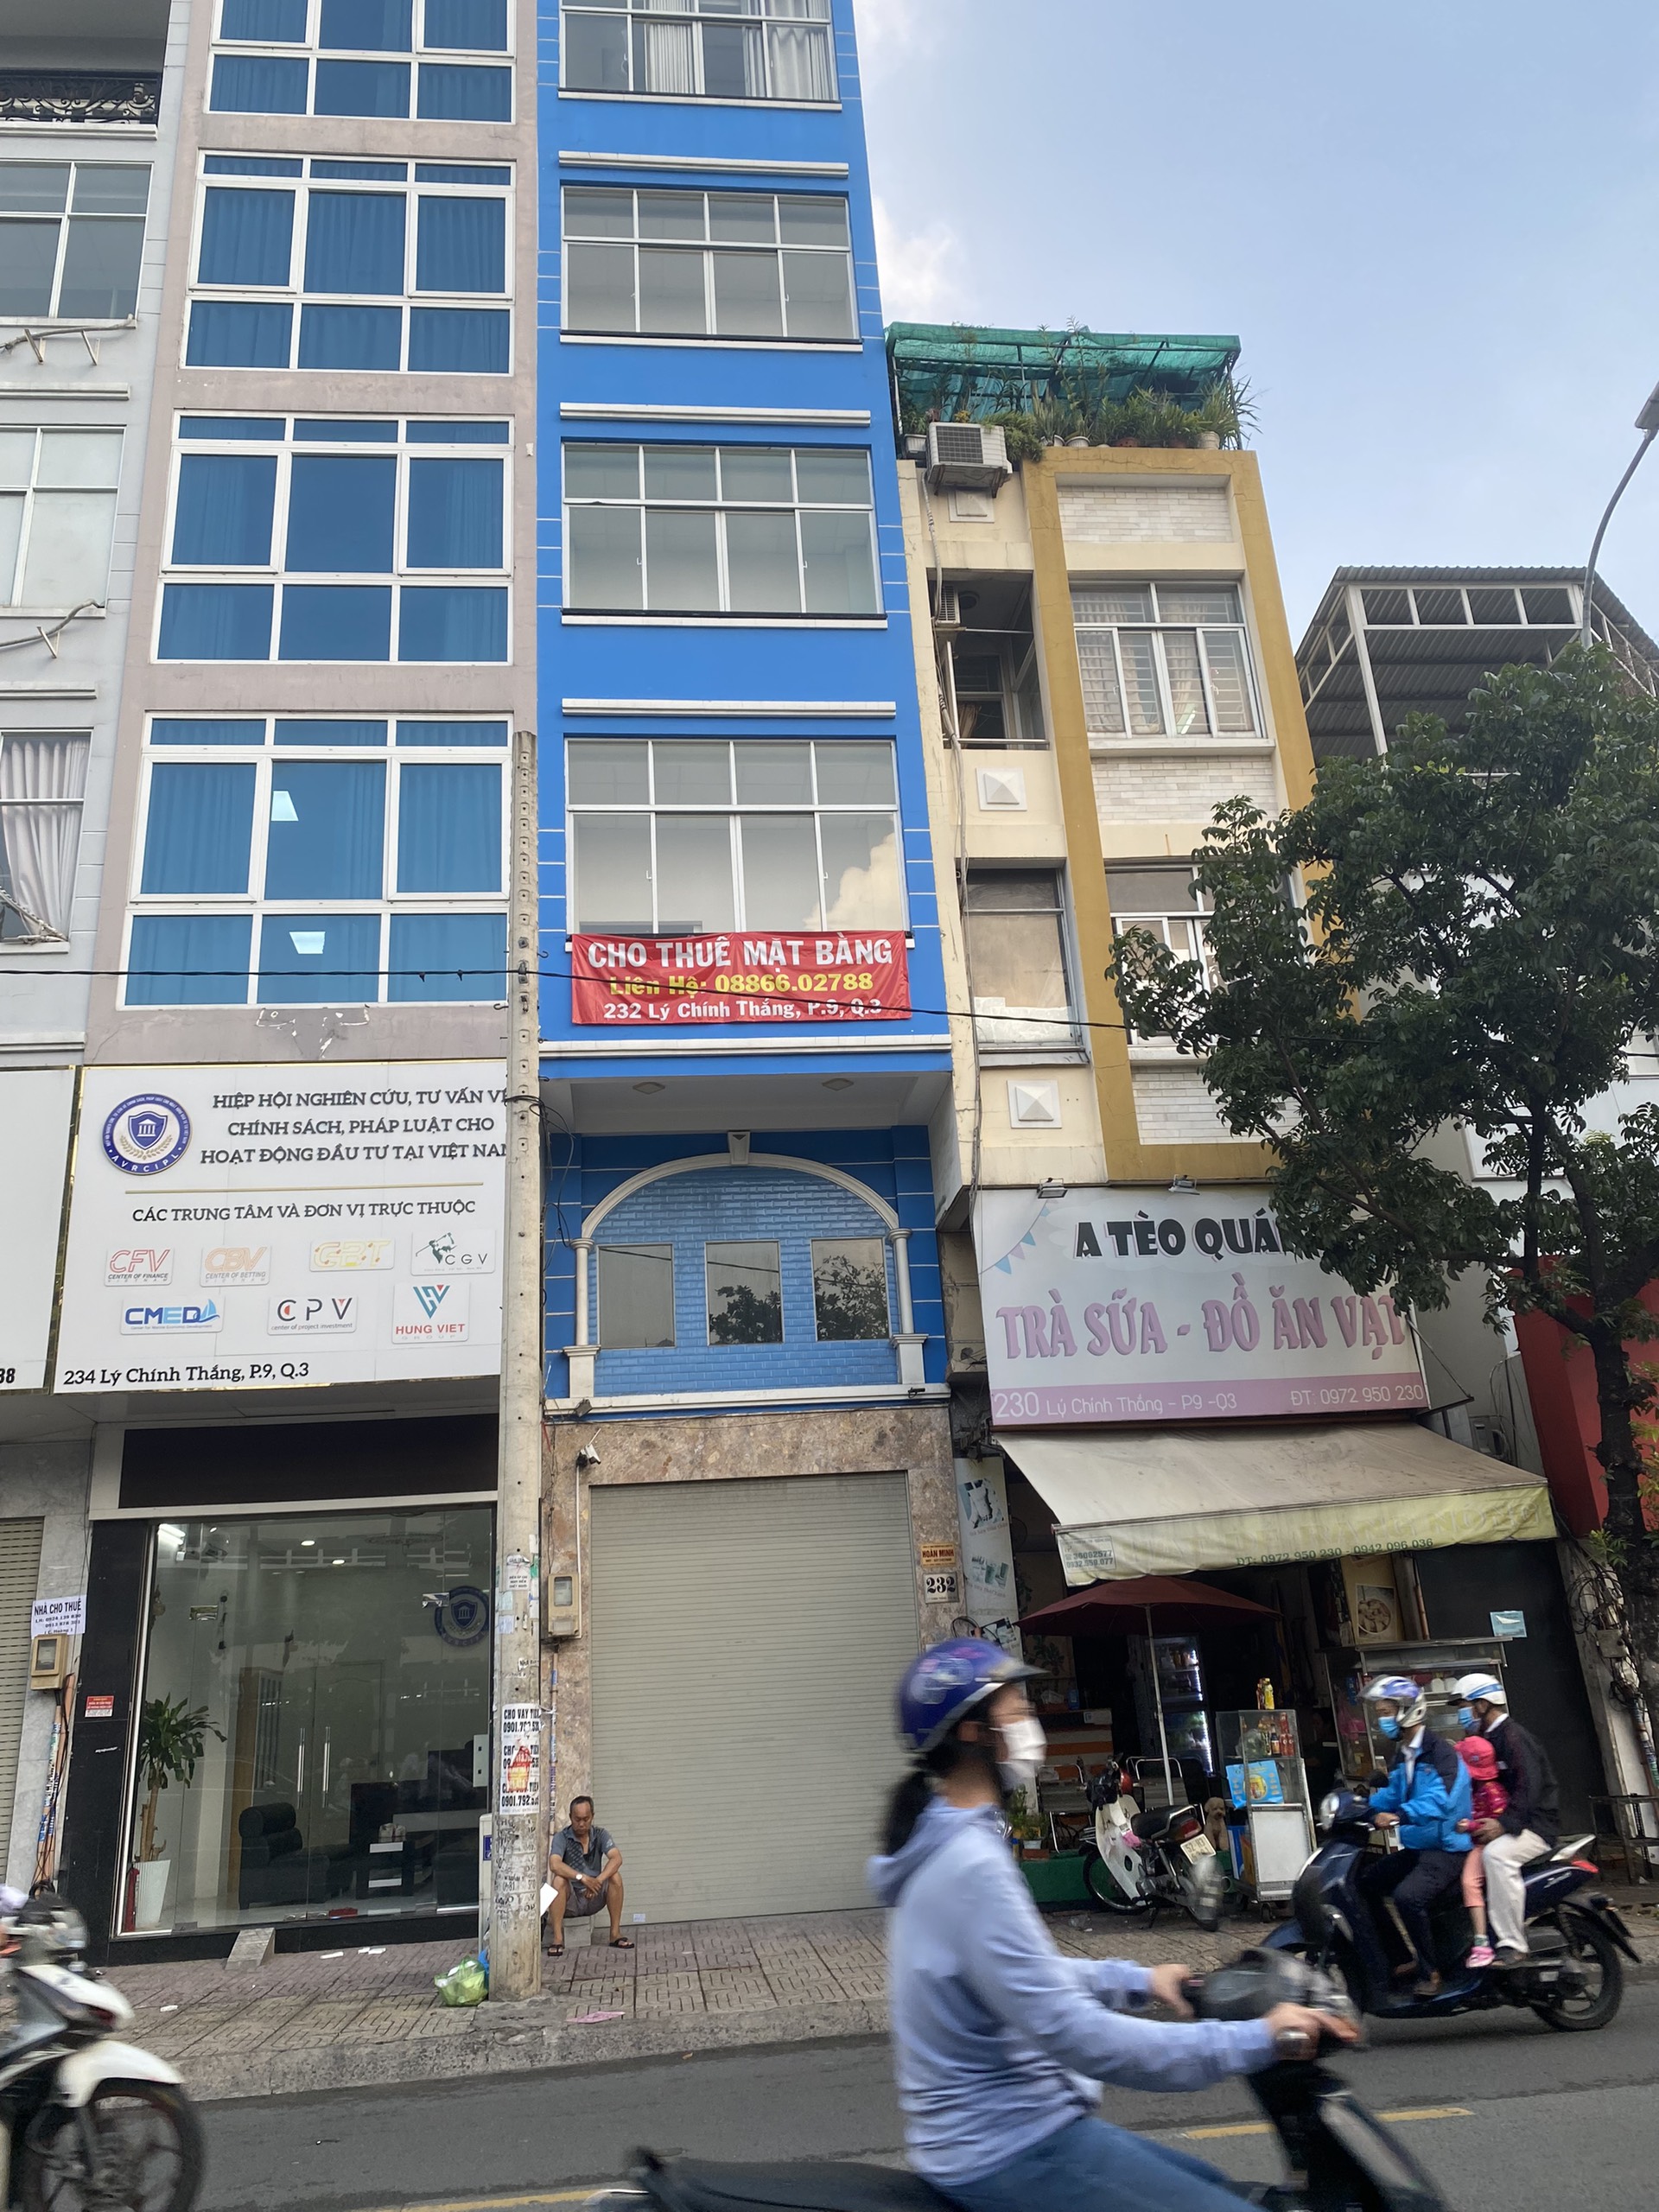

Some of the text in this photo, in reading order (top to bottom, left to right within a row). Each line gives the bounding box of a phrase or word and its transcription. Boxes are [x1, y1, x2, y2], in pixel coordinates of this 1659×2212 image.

[588, 931, 893, 973] CHO THUÊ MẶT BẰNG
[610, 976, 660, 995] Liên
[715, 972, 874, 993] 08866.02788
[603, 997, 882, 1021] 232 Lý Chính Thắng, P.9, Q.3
[213, 1091, 255, 1109] HIỆP
[257, 1091, 292, 1109] HỘI
[296, 1090, 366, 1108] NGHIÊN
[370, 1089, 412, 1106] CỨU,
[416, 1089, 442, 1104] TƯ
[445, 1086, 484, 1104] VẤN
[227, 1116, 495, 1136] CHÍNH SÁCH, PHÁP LUẬT CHO
[200, 1148, 256, 1165] HOẠT
[259, 1146, 314, 1164] ĐỘNG
[316, 1143, 359, 1161] ĐẦU
[363, 1144, 390, 1160] TƯ
[392, 1145, 424, 1161] TẠI
[428, 1141, 469, 1160] VIỆT
[132, 1198, 476, 1222] CÁC TRUNG TÂM VÀ ĐƠN VỊ TRỰC THUỘC
[1073, 1221, 1103, 1259] A
[1104, 1209, 1187, 1259] TÈO
[109, 1249, 171, 1274] CFV
[204, 1246, 268, 1273] CBV
[124, 1306, 202, 1325] CMED
[995, 1287, 1078, 1359] TRÀ
[1084, 1287, 1168, 1357] SỮA
[1201, 1271, 1262, 1353] ĐỒ
[1268, 1285, 1329, 1351] ĂN
[298, 1323, 320, 1332] project
[395, 1323, 466, 1335] HUNG VIET
[63, 1362, 309, 1387] 234 Lý Chính Thắng, P.9, Q.3
[994, 1391, 1040, 1419] 230
[1046, 1398, 1067, 1419] Lý
[1071, 1396, 1114, 1415] Chính
[1116, 1393, 1164, 1415] Thắng
[1180, 1394, 1203, 1410] P9
[1290, 1384, 1424, 1406] ĐT: 0972 950 230
[1261, 1553, 1291, 1564] 0972
[1295, 1550, 1317, 1560] 950
[1319, 1547, 1343, 1558] 230
[1353, 1543, 1382, 1555] 0942
[1386, 1541, 1408, 1552] 096
[1412, 1538, 1434, 1548] 036
[925, 1576, 957, 1594] 232
[34, 1598, 82, 1617] NHÀ CHO THUÊ
[504, 1709, 516, 1720] CHO
[517, 1708, 530, 1719] VAY
